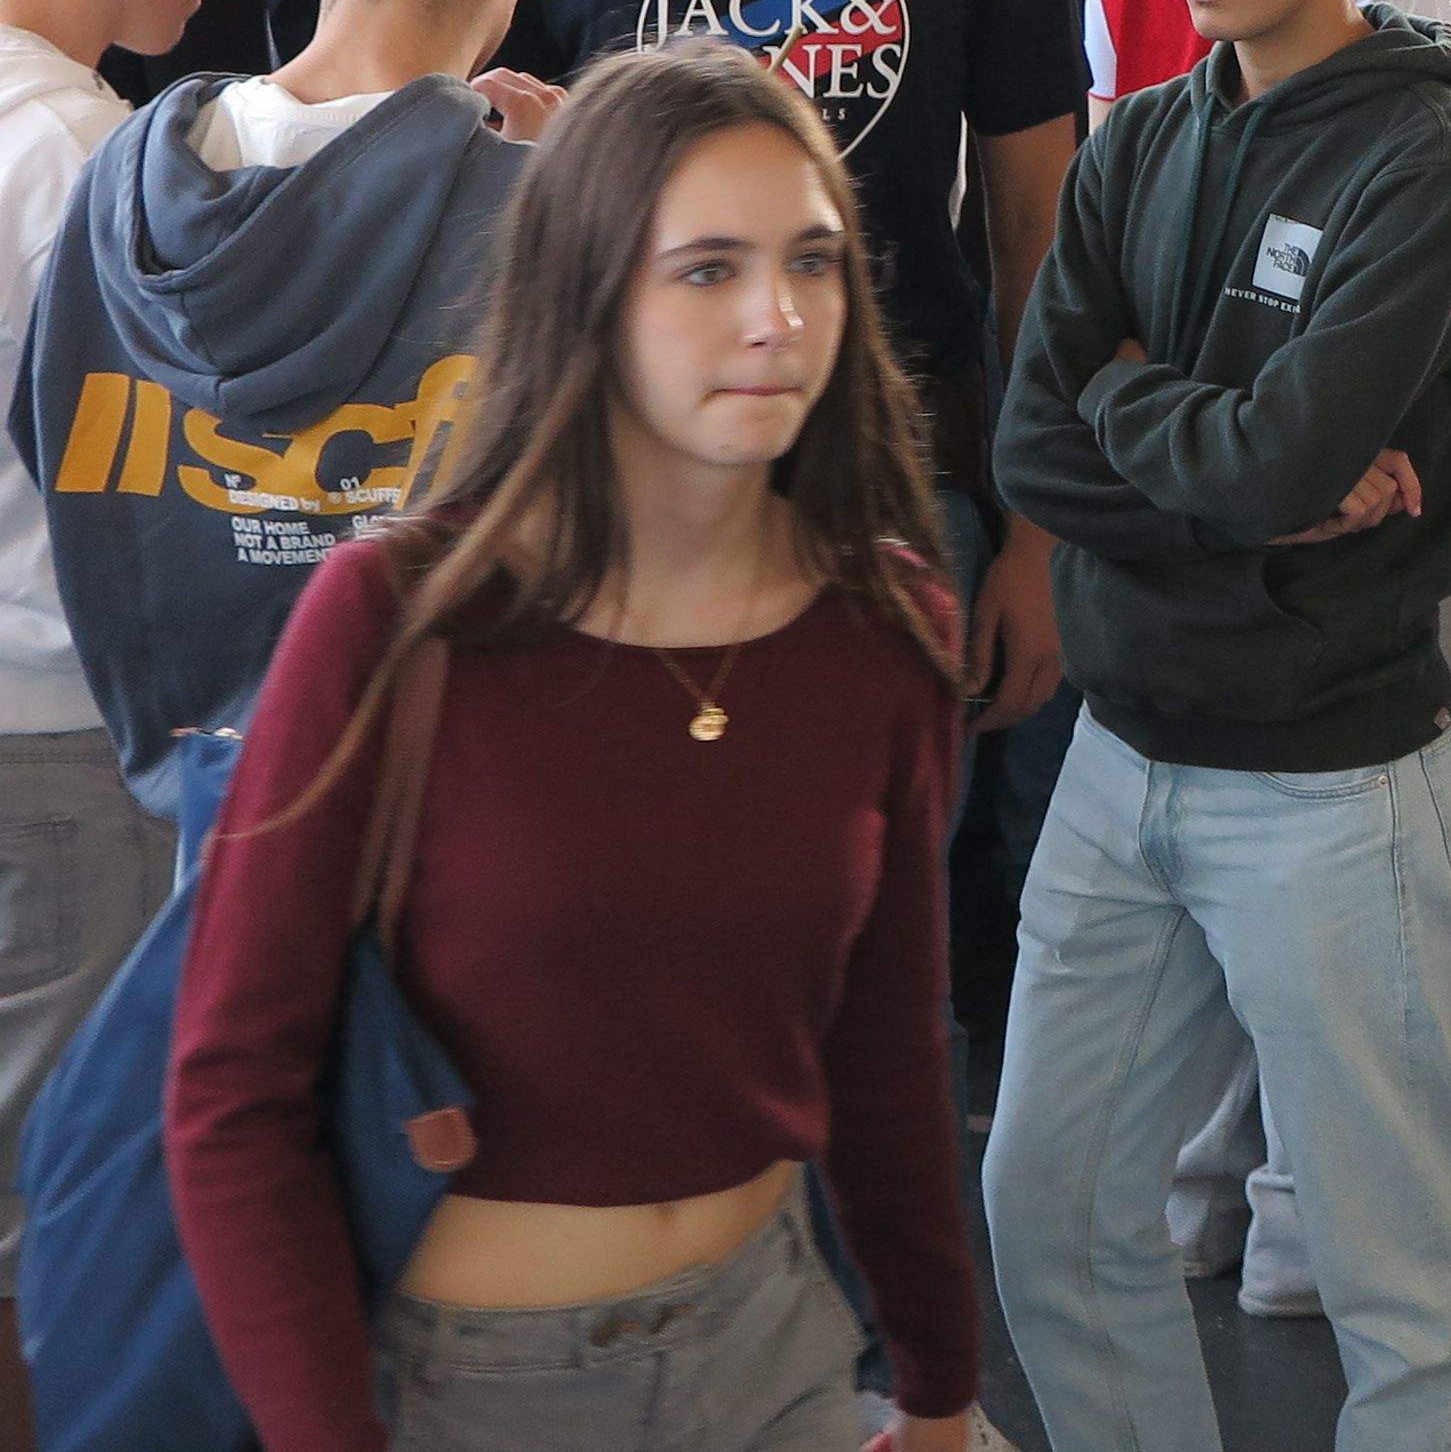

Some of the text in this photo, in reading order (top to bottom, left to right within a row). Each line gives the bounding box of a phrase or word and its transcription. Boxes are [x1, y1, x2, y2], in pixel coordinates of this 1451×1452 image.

[1265, 247, 1299, 266] NORTH
[231, 516, 310, 536] OUR HOME
[234, 532, 263, 550] NOT
[266, 535, 279, 551] A
[280, 533, 337, 550] BRAND
[238, 547, 249, 563] A
